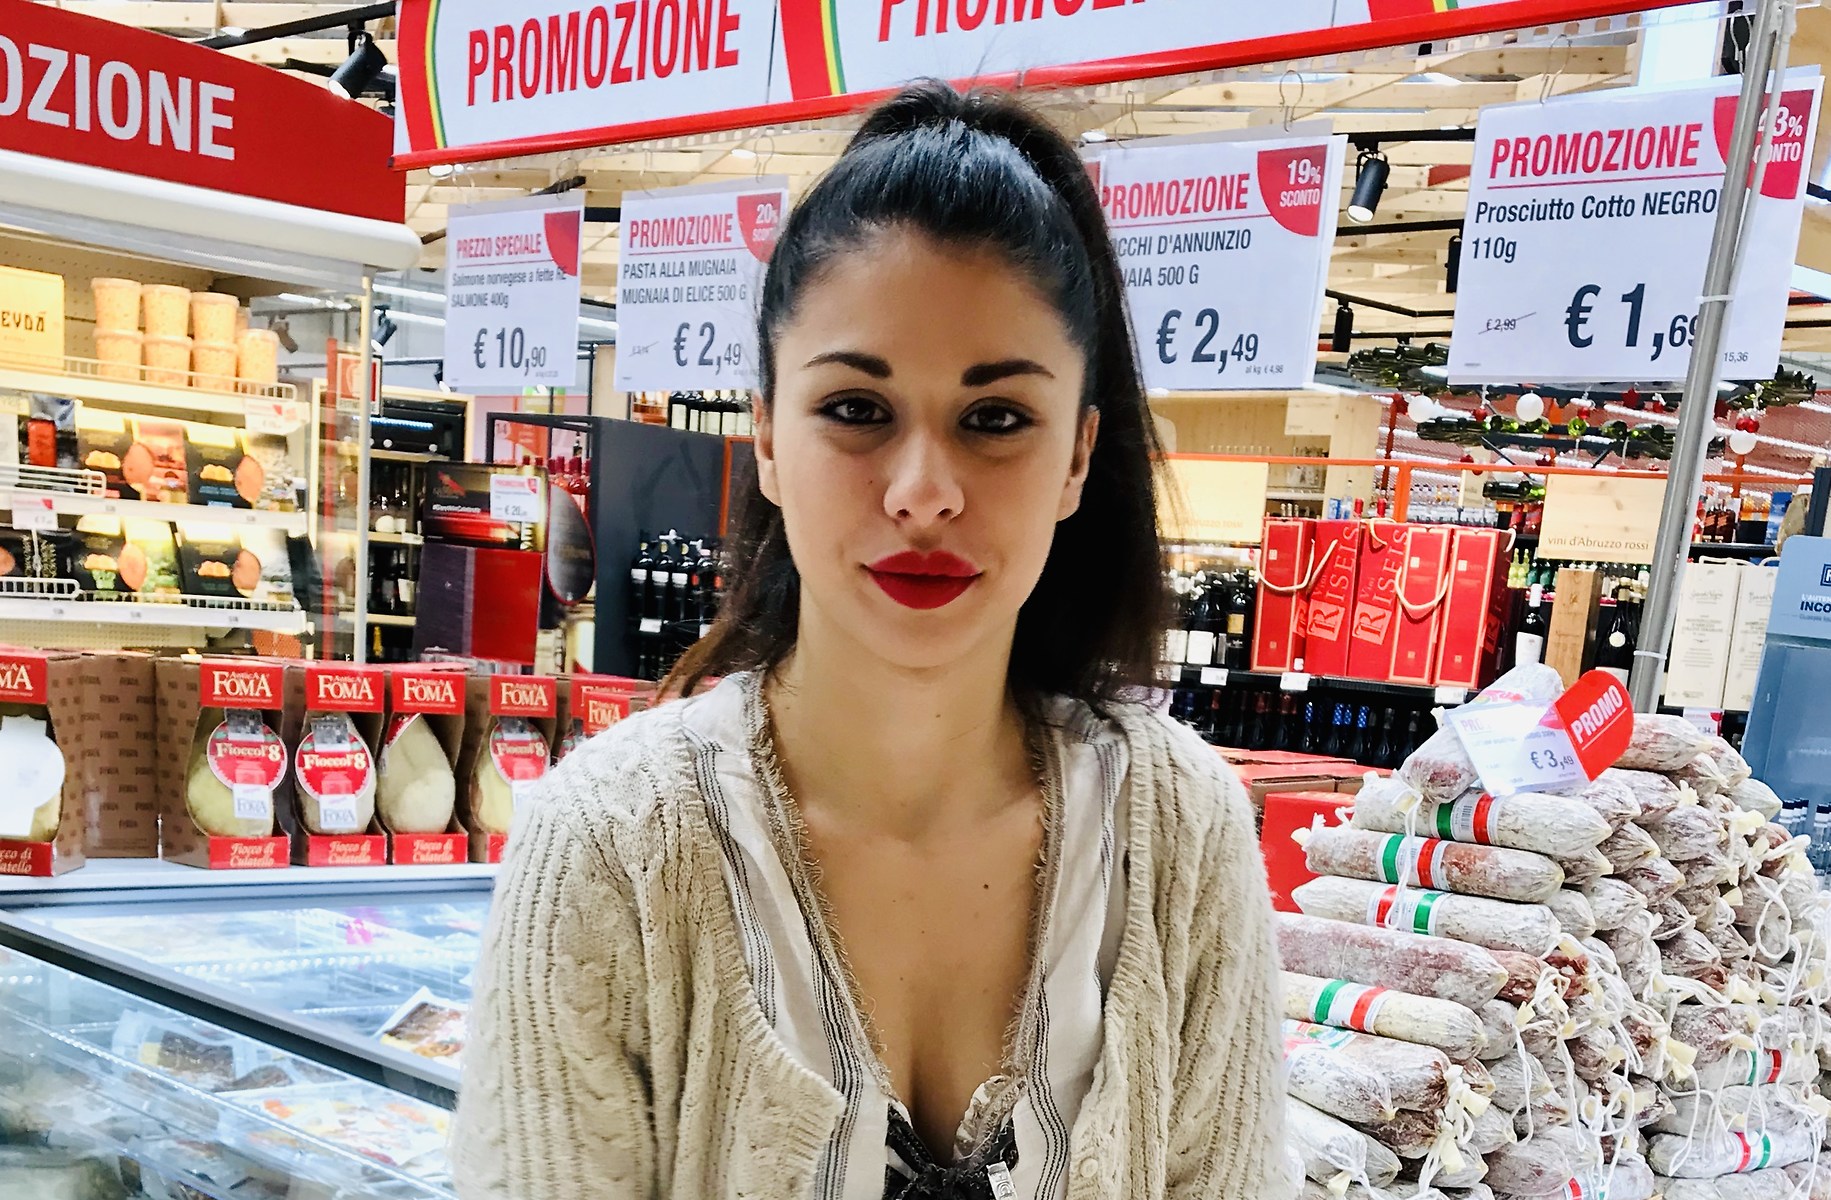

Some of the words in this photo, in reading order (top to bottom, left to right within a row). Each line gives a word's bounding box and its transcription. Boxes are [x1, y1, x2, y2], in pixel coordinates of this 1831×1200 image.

[468, 0, 741, 106] PROMOZIONE
[1489, 123, 1703, 179] PROMOZIONE
[1288, 158, 1321, 186] 19%
[1280, 188, 1320, 207] SCONTO
[1475, 198, 1575, 223] Prosciutto
[1581, 194, 1635, 219] Cotto
[1642, 188, 1722, 217] NEGRO
[629, 213, 734, 248] PROMOZIONE
[1157, 229, 1251, 255] D'ANNUNZIO
[456, 238, 493, 259] PREZZO
[495, 233, 542, 256] SPECIALE
[1472, 236, 1517, 263] 110g
[452, 272, 485, 287] Salmone
[486, 270, 527, 287] norvegese
[535, 268, 554, 283] fette
[623, 262, 657, 279] PASTA
[660, 260, 685, 277] ALLA
[688, 258, 737, 276] MUGNAIA
[1157, 265, 1184, 286] 500
[1189, 264, 1200, 284] G
[451, 292, 489, 308] SALMONE
[491, 292, 509, 309] 400g
[622, 287, 670, 304] MUGNAIA
[673, 286, 683, 303] DI
[686, 285, 714, 303] ELICE
[717, 284, 737, 301] 500
[739, 284, 747, 300] G
[1564, 284, 1602, 348] €
[473, 328, 488, 369] €
[496, 327, 547, 376] 10,90
[673, 321, 691, 367] €
[697, 321, 742, 376] 2,49
[1156, 309, 1182, 365] €
[1190, 308, 1259, 374] 2,49
[1723, 352, 1749, 364] 15,36
[1548, 537, 1566, 546] vini
[1569, 536, 1622, 549] d'Abruzzo
[1624, 541, 1649, 550] rossi
[212, 670, 273, 697] FOMA
[317, 674, 375, 700] FOMA
[402, 677, 456, 703] FOMA
[501, 683, 549, 707] FOMA
[588, 701, 622, 725] FOMA
[1570, 685, 1623, 744] PROMO
[1530, 751, 1544, 770] €
[1544, 750, 1575, 771] 3,49
